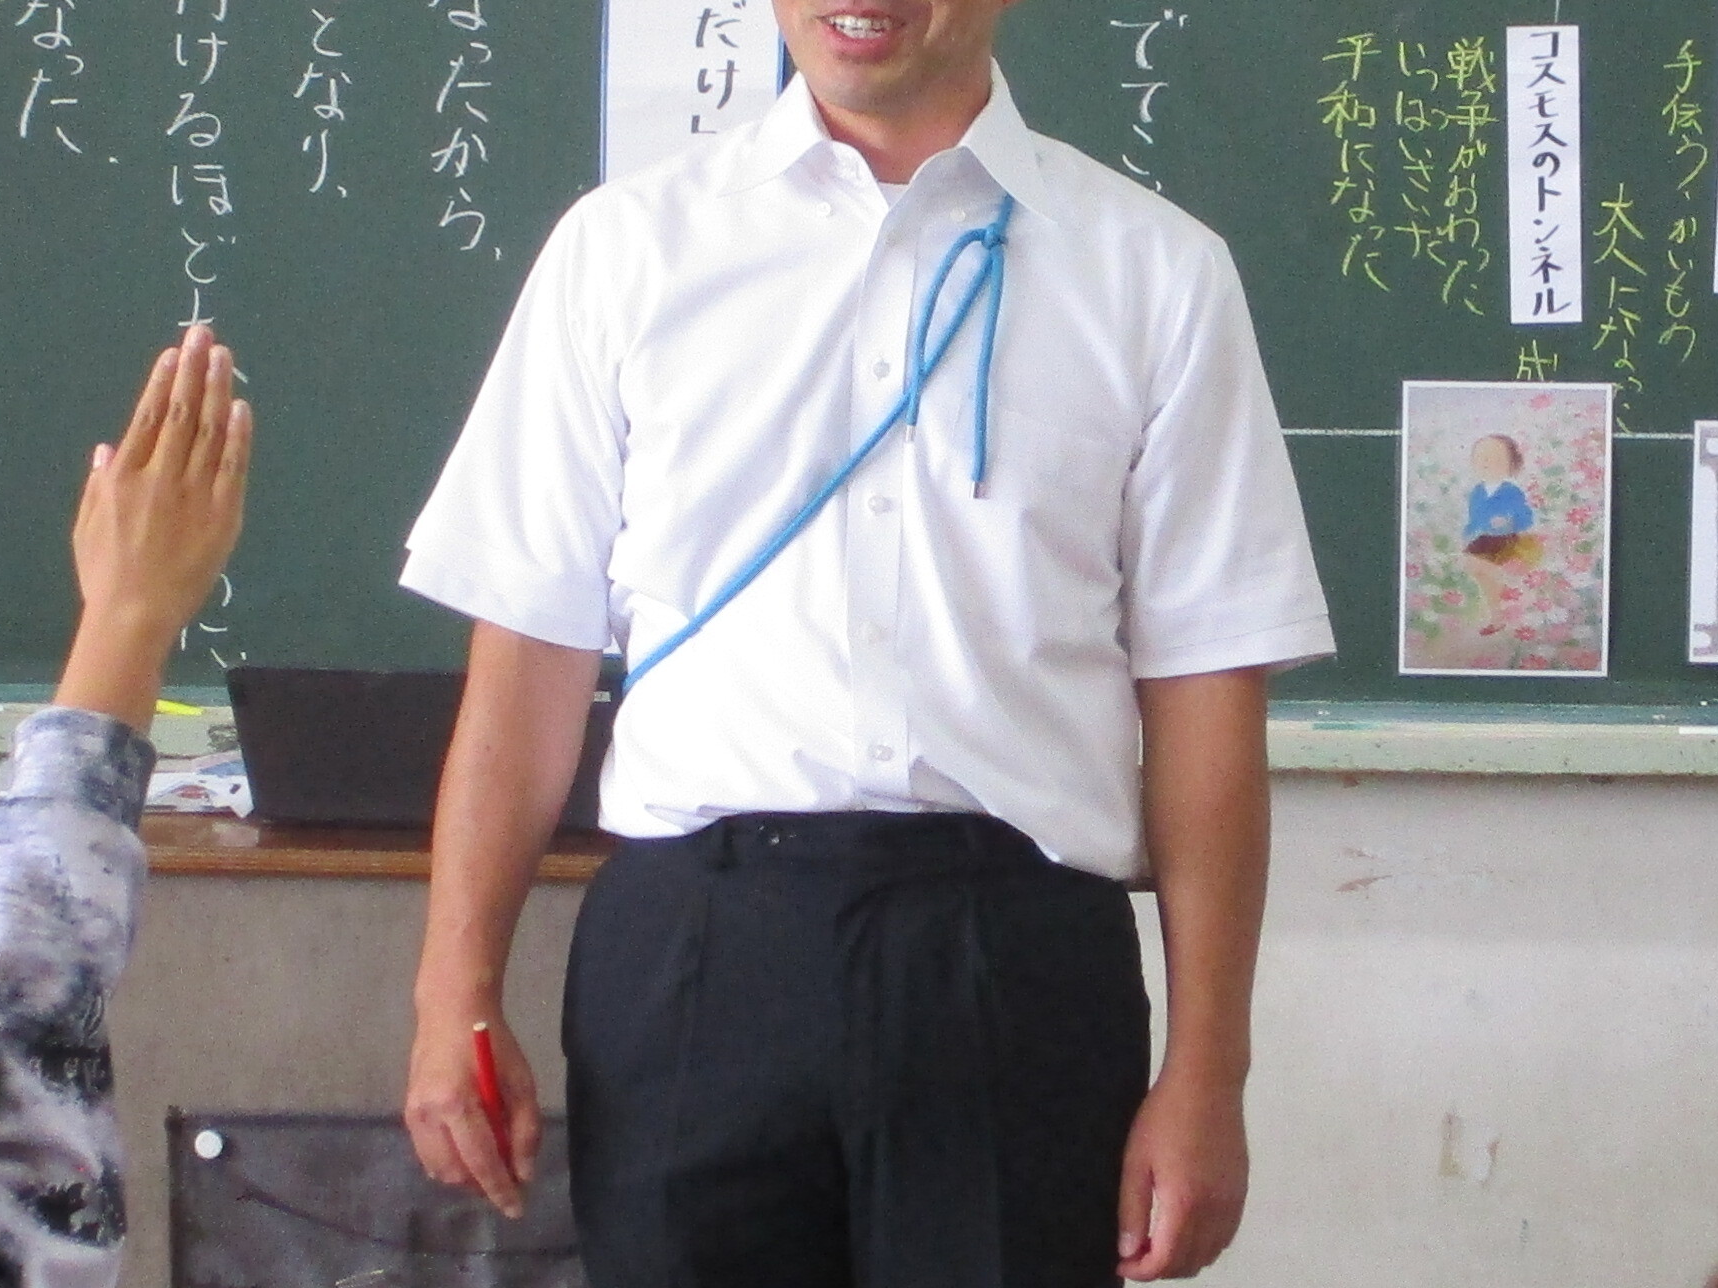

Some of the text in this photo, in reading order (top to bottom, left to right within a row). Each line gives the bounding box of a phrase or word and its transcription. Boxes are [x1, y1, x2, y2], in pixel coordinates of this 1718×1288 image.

[1527, 31, 1572, 316] コスモスのトンネル
